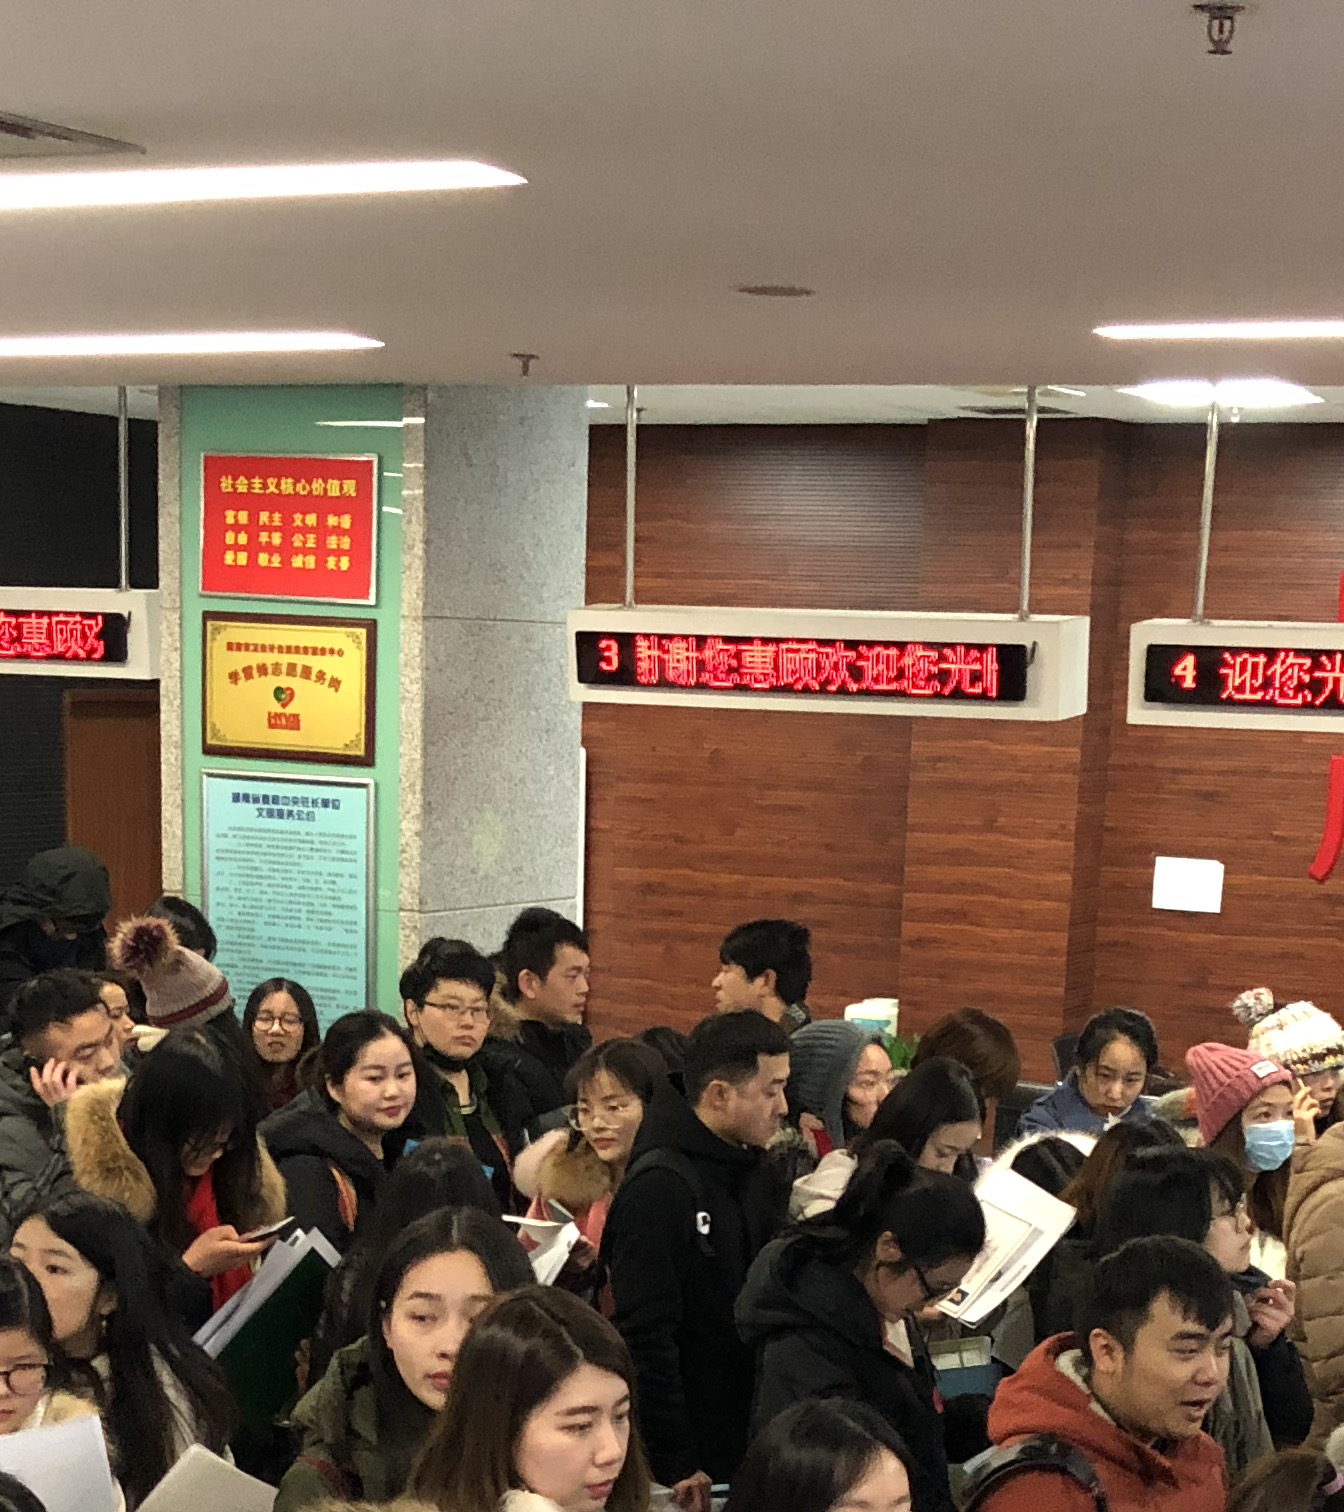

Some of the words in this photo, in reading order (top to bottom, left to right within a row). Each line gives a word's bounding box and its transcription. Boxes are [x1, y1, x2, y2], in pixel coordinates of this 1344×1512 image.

[220, 475, 357, 496] 社会主义核心价值观
[258, 511, 283, 526] 民主
[292, 512, 317, 527] 文明
[292, 533, 317, 548] 公正
[598, 638, 620, 673] 3
[1170, 652, 1198, 690] 4
